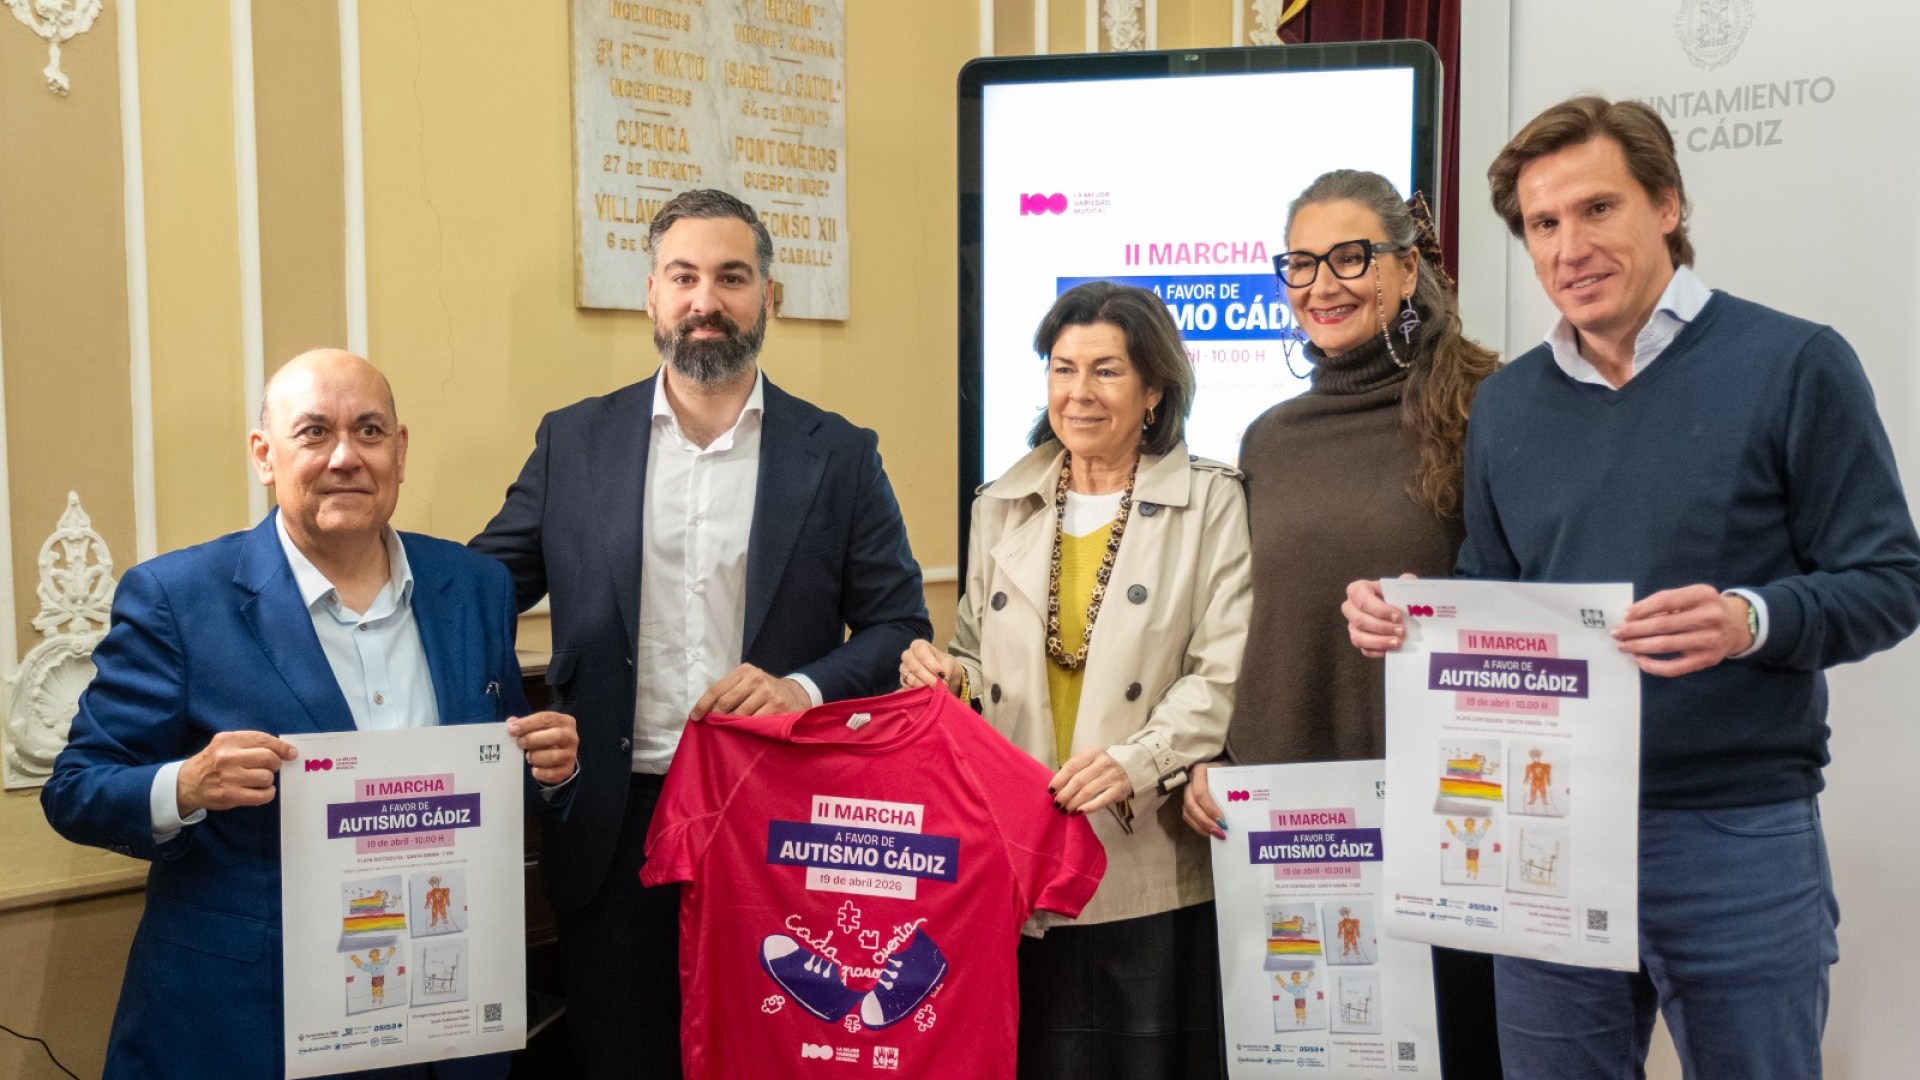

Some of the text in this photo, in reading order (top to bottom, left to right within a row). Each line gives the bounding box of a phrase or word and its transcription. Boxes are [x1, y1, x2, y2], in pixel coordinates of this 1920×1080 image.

[610, 0, 691, 33] INGENIEROS
[790, 35, 835, 59] MARINA
[654, 48, 707, 82] MIXTO
[725, 60, 773, 93] ISABEL
[611, 77, 692, 107] INGENIEROS
[1650, 77, 1835, 119] NTAMIENTO
[763, 106, 777, 120] DE
[616, 119, 690, 155] CUENCA
[1686, 118, 1783, 153] CÁDIZ
[735, 136, 837, 173] PONTONEROS
[603, 154, 621, 173] 27
[626, 161, 642, 176] DE
[743, 171, 793, 193] CUERPO
[1020, 193, 1068, 216] 100
[817, 217, 836, 243] XII
[607, 232, 616, 249] 6
[621, 238, 636, 251] DE
[1125, 241, 1268, 266] II MARCHA
[1166, 284, 1215, 299] FAVOR
[1219, 283, 1240, 299] DE
[1212, 350, 1250, 363] 10.00
[1256, 350, 1265, 362] H
[1406, 605, 1434, 617] 100
[1468, 635, 1548, 652] II MARCHA
[1483, 659, 1533, 671] A FAVOR DE
[1439, 669, 1578, 692] AUTISMO CÁDIZ
[1466, 697, 1548, 710] 19 de abril 10.00 H
[305, 758, 333, 772] 100
[366, 779, 444, 796] II MARCHA
[1227, 790, 1250, 802] 100
[381, 801, 429, 813] A FAVOR DE
[818, 802, 916, 826] II MARCHA
[338, 806, 471, 833] AUTISMO CÁDIZ
[1278, 812, 1347, 826] II MARCHA
[367, 834, 445, 848] 19 de abril 10.00 H
[834, 832, 895, 847] A FAVOR DE
[1293, 833, 1335, 843] A FAVOR DE
[779, 840, 946, 875] AUTISMO CÁDIZ
[1259, 839, 1374, 859] AUTISMO CÁDIZ
[1283, 867, 1290, 875] 19
[1302, 866, 1320, 874] abril
[1324, 866, 1344, 874] 10.00
[820, 874, 902, 891] 19 de abril 2026
[841, 966, 884, 987] paso
[801, 1042, 834, 1060] 100
